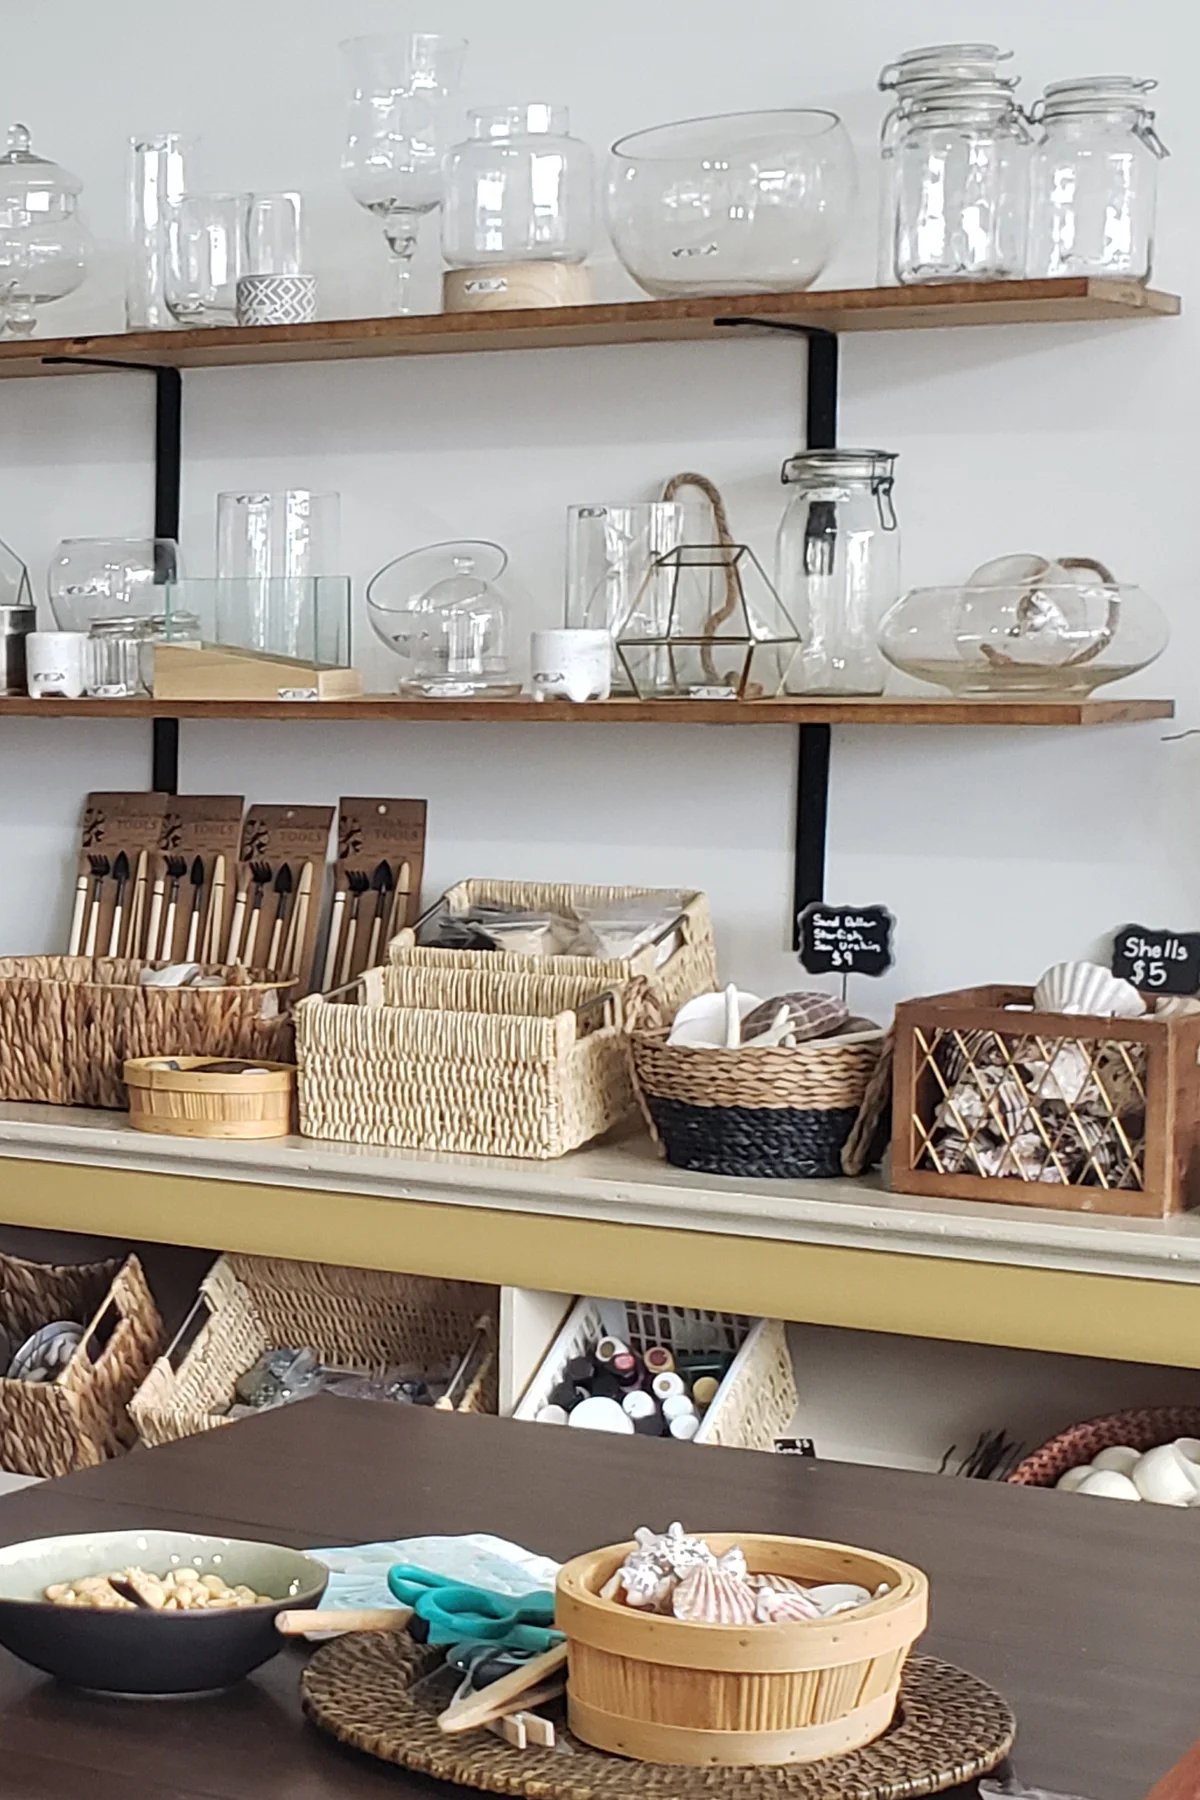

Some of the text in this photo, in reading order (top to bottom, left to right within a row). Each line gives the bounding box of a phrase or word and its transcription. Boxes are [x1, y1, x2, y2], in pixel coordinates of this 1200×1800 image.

[831, 950, 853, 966] $9
[1123, 936, 1188, 960] Shells
[1129, 959, 1168, 986] $5
